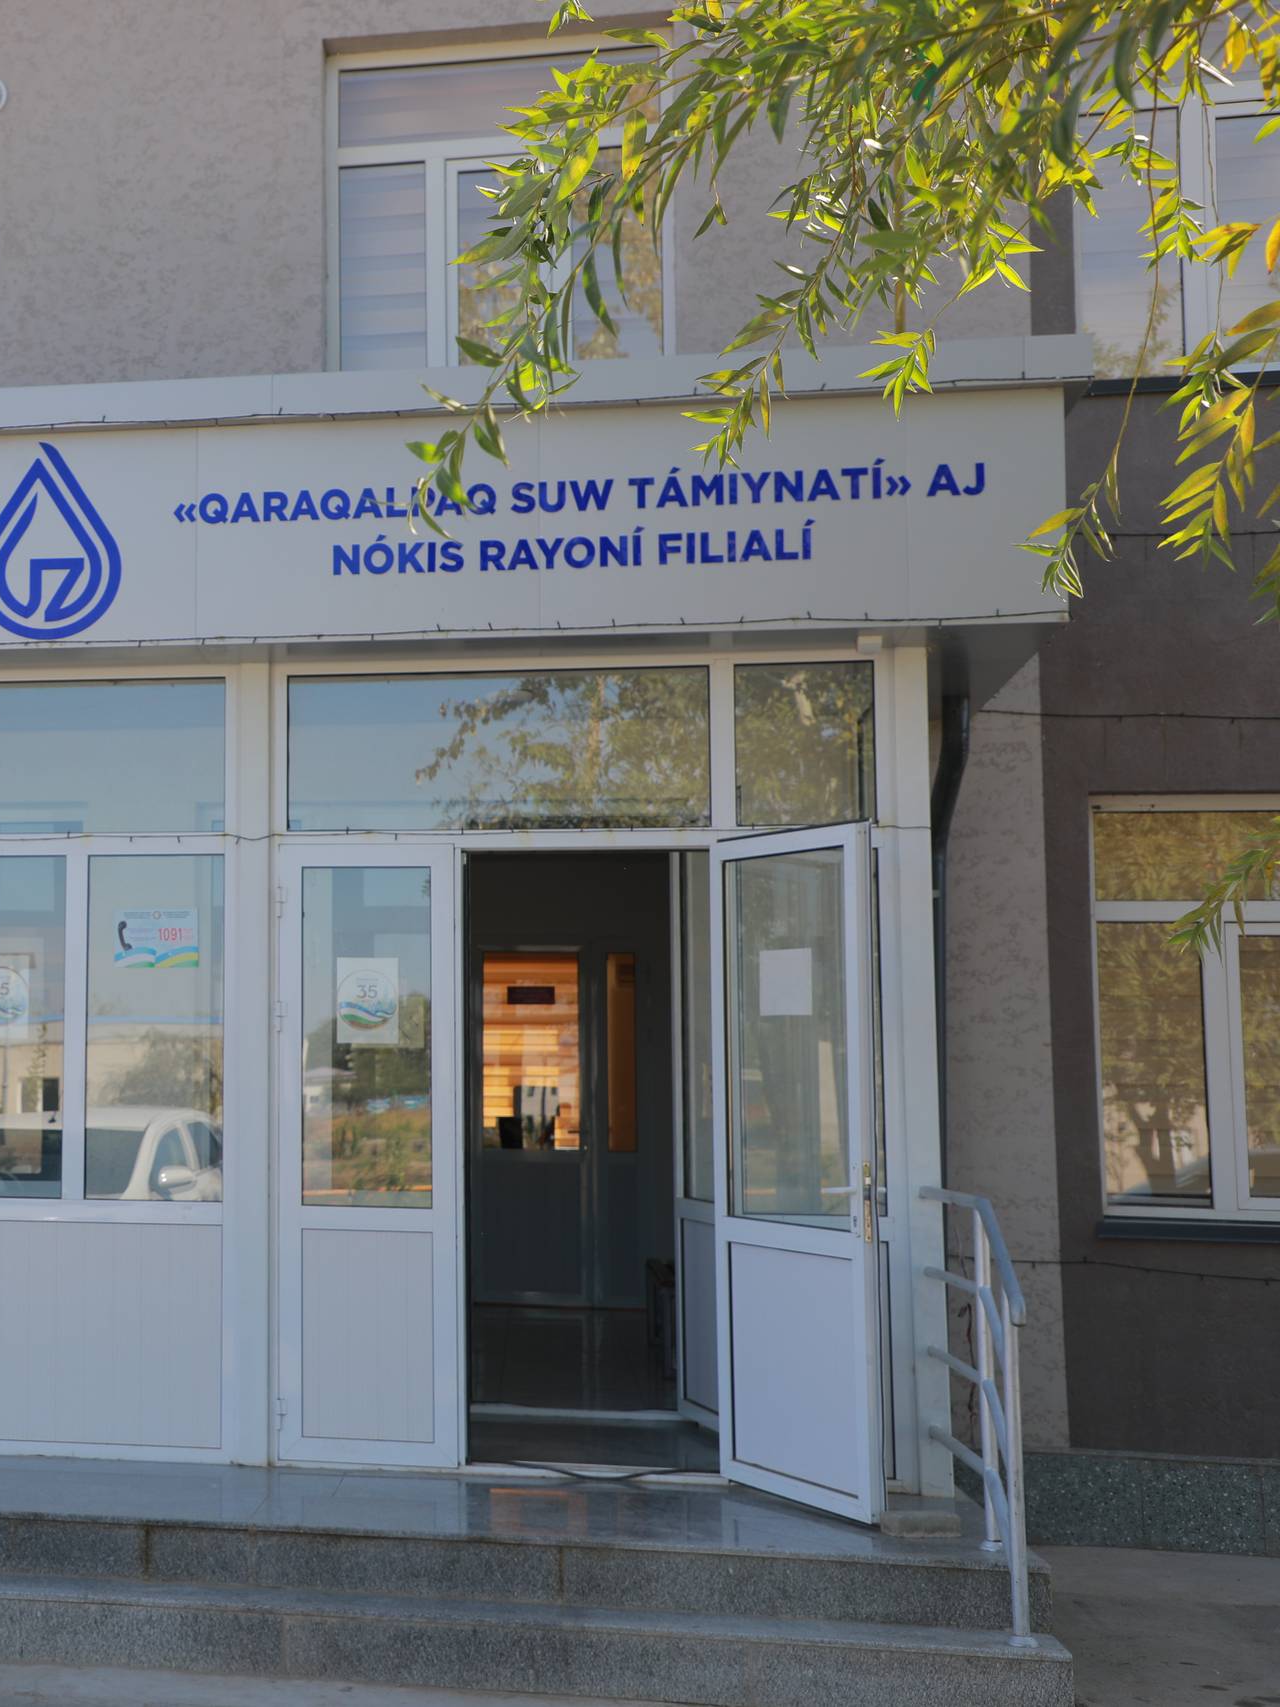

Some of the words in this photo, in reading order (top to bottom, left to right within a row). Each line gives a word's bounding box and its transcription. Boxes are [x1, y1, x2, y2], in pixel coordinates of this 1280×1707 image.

[511, 478, 615, 514] SUW
[628, 457, 913, 509] TÁMIYNATÍ»
[927, 463, 986, 497] AJ
[332, 533, 465, 577] NÓKIS
[480, 526, 643, 573] RAYONÍ
[658, 518, 816, 566] FILIALÍ
[158, 928, 183, 941] 1091
[356, 984, 378, 999] 35
